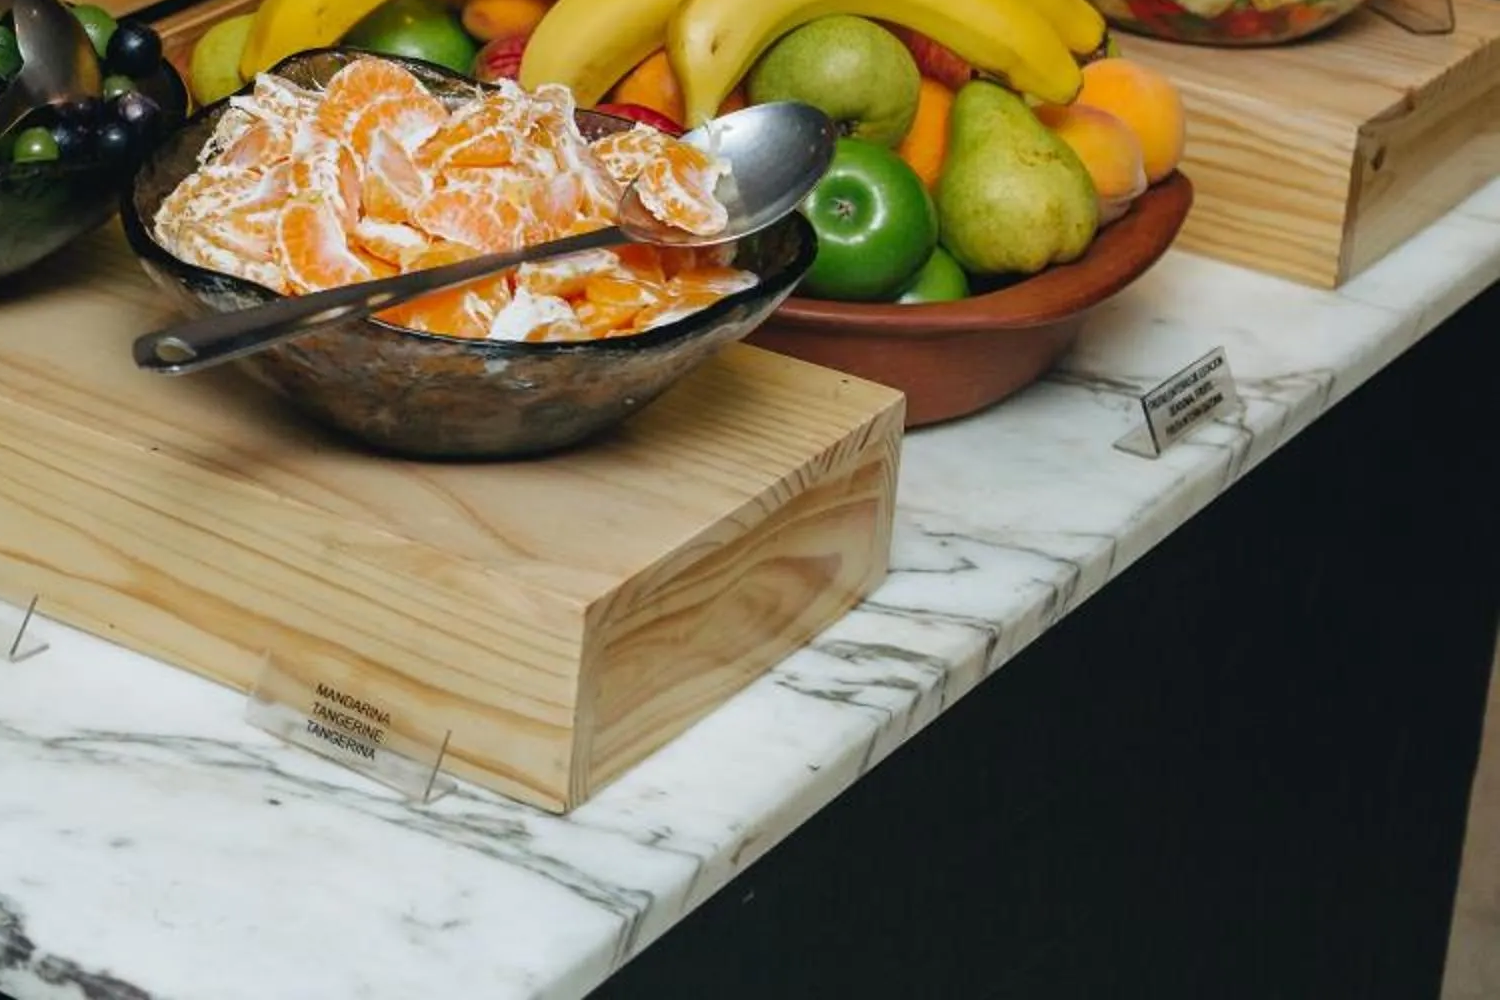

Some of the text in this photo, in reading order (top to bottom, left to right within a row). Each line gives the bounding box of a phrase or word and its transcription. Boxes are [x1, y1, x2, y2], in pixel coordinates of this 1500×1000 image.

[312, 701, 385, 744] TANGERINE
[315, 683, 392, 726] MANDARINA
[307, 719, 376, 761] TANGERINA
